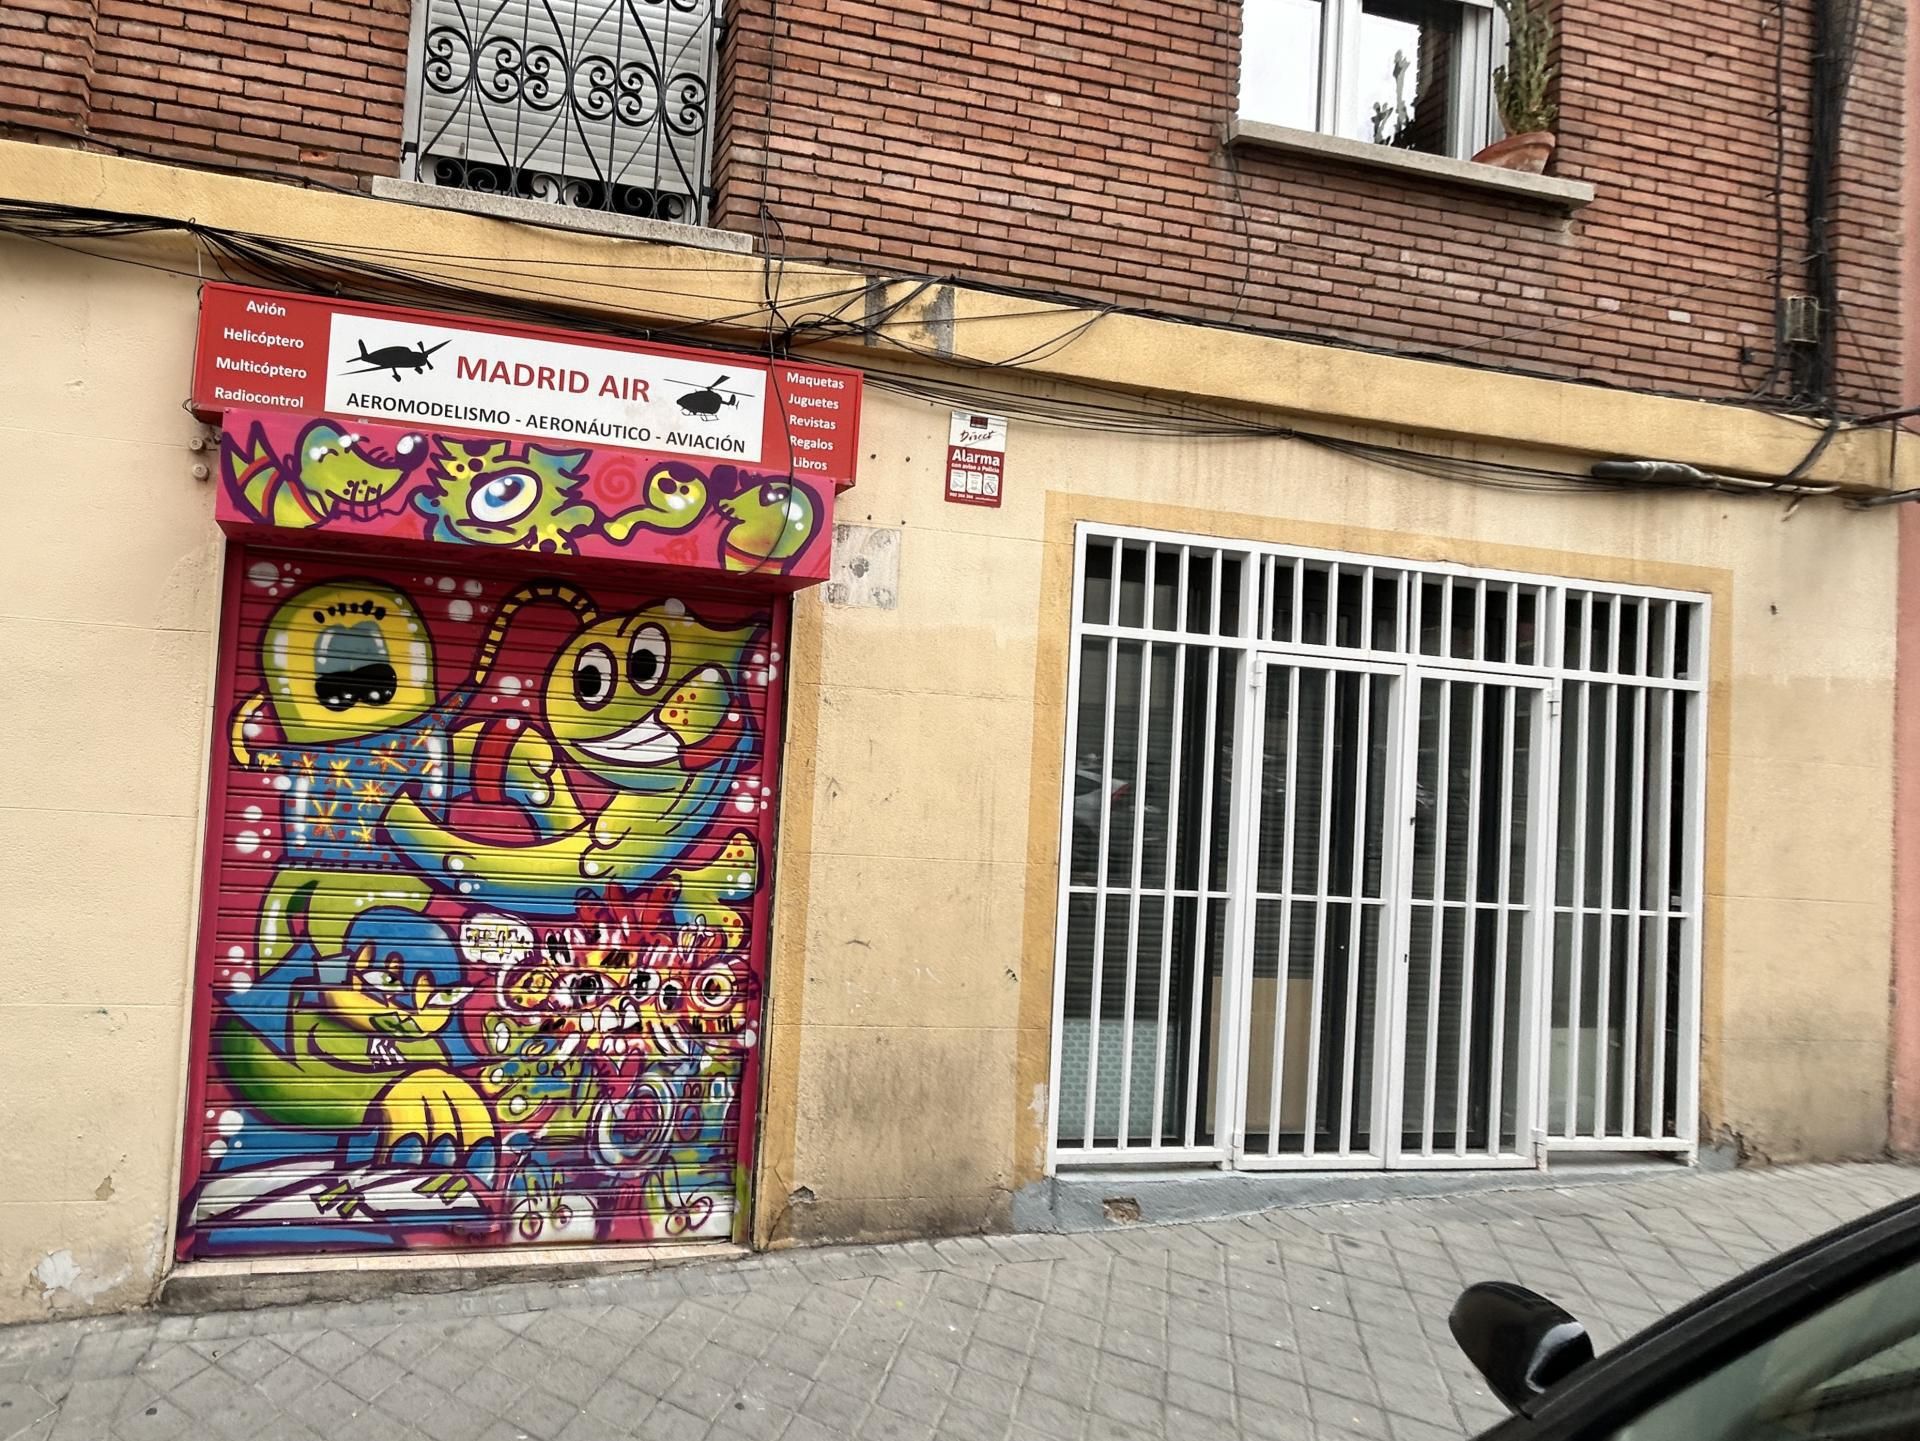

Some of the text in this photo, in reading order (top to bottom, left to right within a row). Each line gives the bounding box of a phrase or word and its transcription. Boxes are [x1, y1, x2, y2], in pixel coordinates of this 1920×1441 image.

[246, 300, 286, 317] Avión
[223, 327, 304, 349] Helicóptero
[216, 356, 307, 379] Multicóptero
[456, 355, 651, 405] MADRID AIR
[786, 371, 845, 390] Maquetas
[214, 386, 304, 409] Radiocontrol
[788, 393, 839, 410] Juguetes
[346, 392, 511, 426] AEROMODELISMO
[525, 413, 651, 443] AERONÁUTICO
[665, 430, 746, 454] AVIACIÓN
[789, 414, 837, 430] Revistas
[789, 434, 834, 451] Regalos
[960, 429, 995, 442] Direct
[793, 456, 828, 471] Libros
[951, 448, 1001, 467] Alarma
